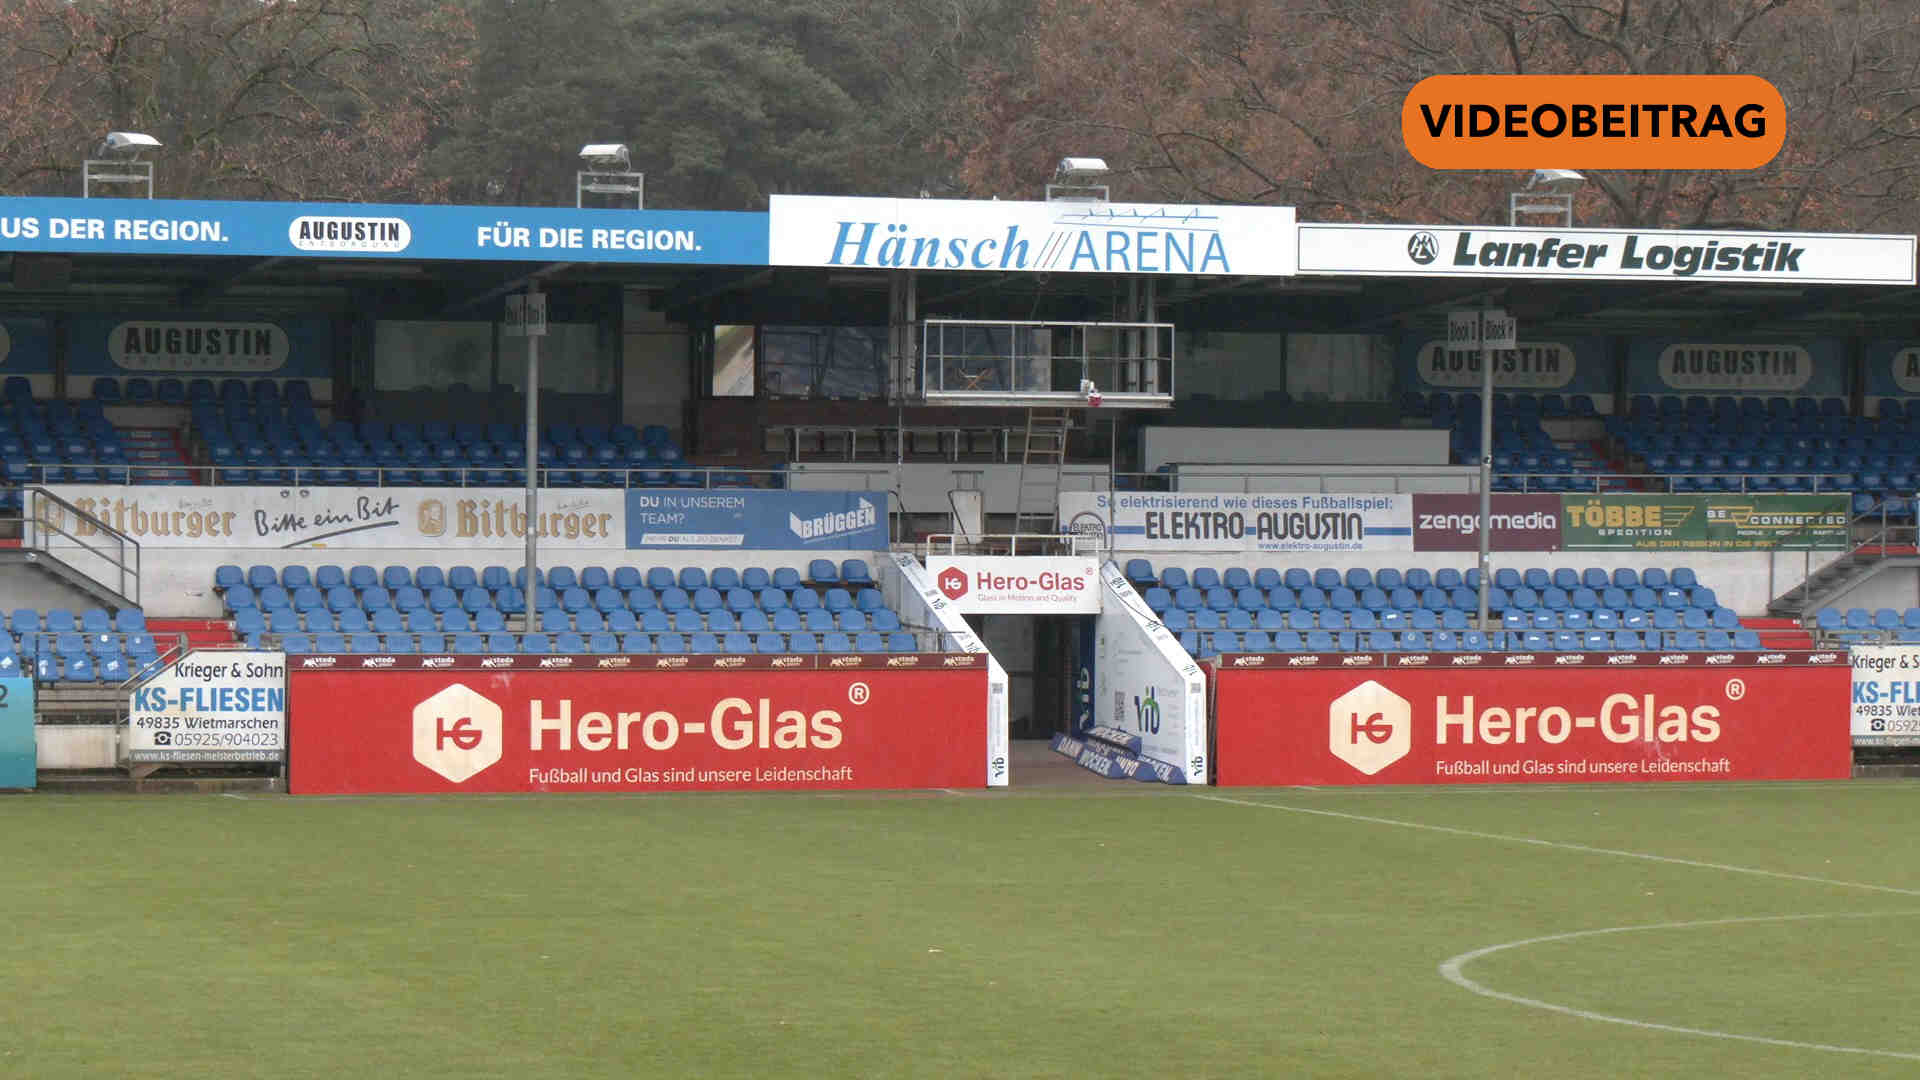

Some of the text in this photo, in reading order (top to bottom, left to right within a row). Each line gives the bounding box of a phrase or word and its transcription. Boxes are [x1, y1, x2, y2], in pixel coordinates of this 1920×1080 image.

[49, 218, 105, 239] DER
[114, 219, 228, 242] REGION.
[299, 221, 400, 241] AUGUSTIN
[477, 221, 702, 251] FÜR DIE REGION.
[825, 221, 1230, 273] Hänsch ARENA
[1452, 231, 1804, 276] Lanfer Logistik
[124, 327, 272, 356] AUGUSTIN
[1672, 350, 1797, 375] AUGUSTIN
[640, 496, 744, 509] DU IN UNSEREM
[1121, 496, 1218, 508] elektrisierend
[1223, 496, 1247, 508] wie
[1252, 495, 1298, 509] dieses
[1303, 495, 1393, 511] Fußballspiel:
[1567, 499, 1662, 528] TÖBBE
[255, 496, 399, 536] Bitte ein Bit
[640, 512, 686, 525] TEAM?
[799, 504, 876, 538] BRÜGGEN
[1146, 511, 1363, 540] ELEKTRO AUGUSTIN
[1598, 528, 1673, 536] SPEDITION
[977, 571, 1085, 591] Hero-Glas
[175, 662, 284, 682] Krieger & Sohn
[1852, 655, 1896, 673] Krieger
[1900, 654, 1910, 669] &
[135, 687, 284, 712] KS-FLIESEN
[1856, 705, 1892, 716] 49835
[137, 717, 279, 729] 49835 Wietmarschen
[530, 698, 842, 751] Hero-Glas
[1436, 693, 1720, 745] Hero-Glas
[175, 733, 278, 746] 05925/904023
[529, 766, 853, 784] Fußball und Glas sind unsere Leidenschaft
[1436, 758, 1731, 775] Fußball und Glas sind unsere Leidenschaft
